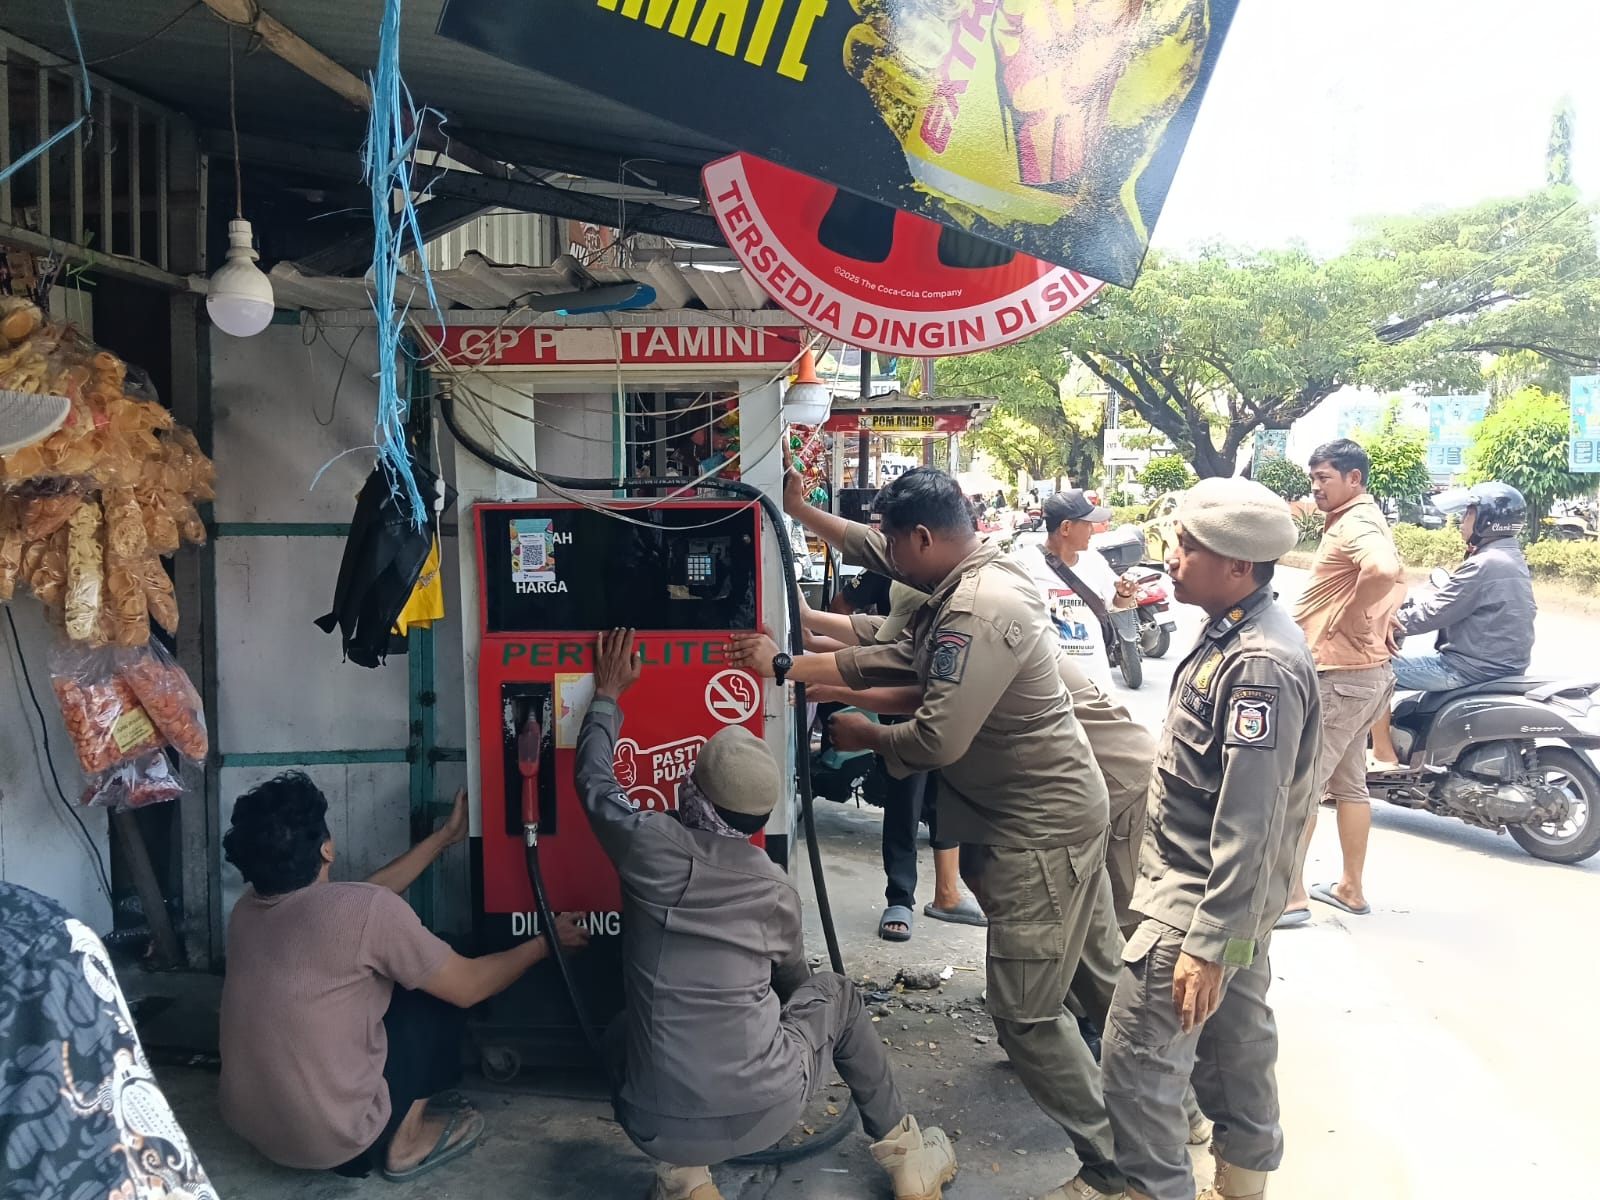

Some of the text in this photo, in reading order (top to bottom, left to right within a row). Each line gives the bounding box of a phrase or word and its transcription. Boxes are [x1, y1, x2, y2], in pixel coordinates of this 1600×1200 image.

[717, 180, 841, 330] TERSEDIA
[851, 312, 986, 349] DINGIN
[995, 299, 1037, 335] DI
[861, 279, 876, 290] The
[877, 285, 920, 298] Coca-Cola
[921, 289, 962, 299] Company
[459, 329, 519, 360] GP
[873, 416, 894, 427] POM
[922, 416, 935, 427] 99
[516, 580, 568, 594] HARGA
